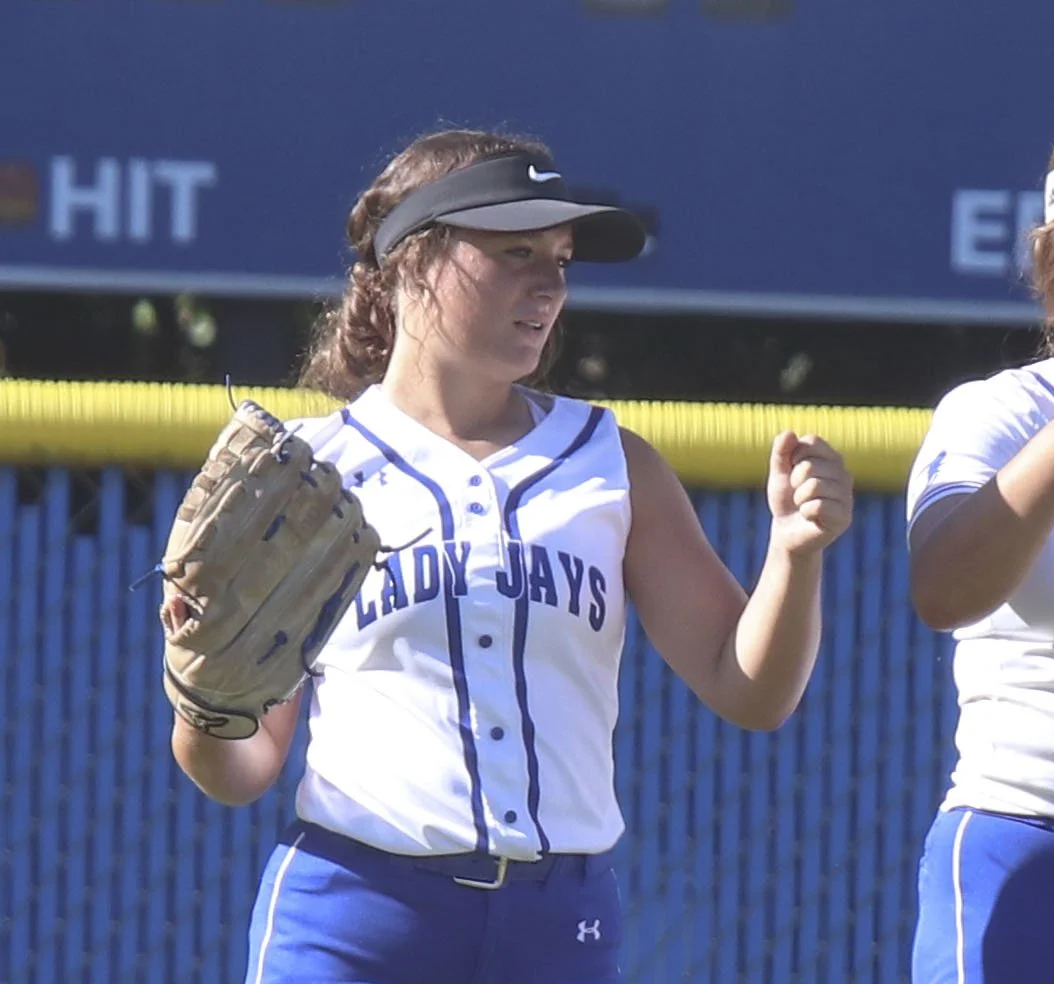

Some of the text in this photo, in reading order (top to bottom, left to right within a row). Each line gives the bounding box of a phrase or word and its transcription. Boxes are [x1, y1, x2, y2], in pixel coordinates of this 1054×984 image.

[51, 155, 216, 241] HIT
[354, 540, 606, 632] LADY JAYS
